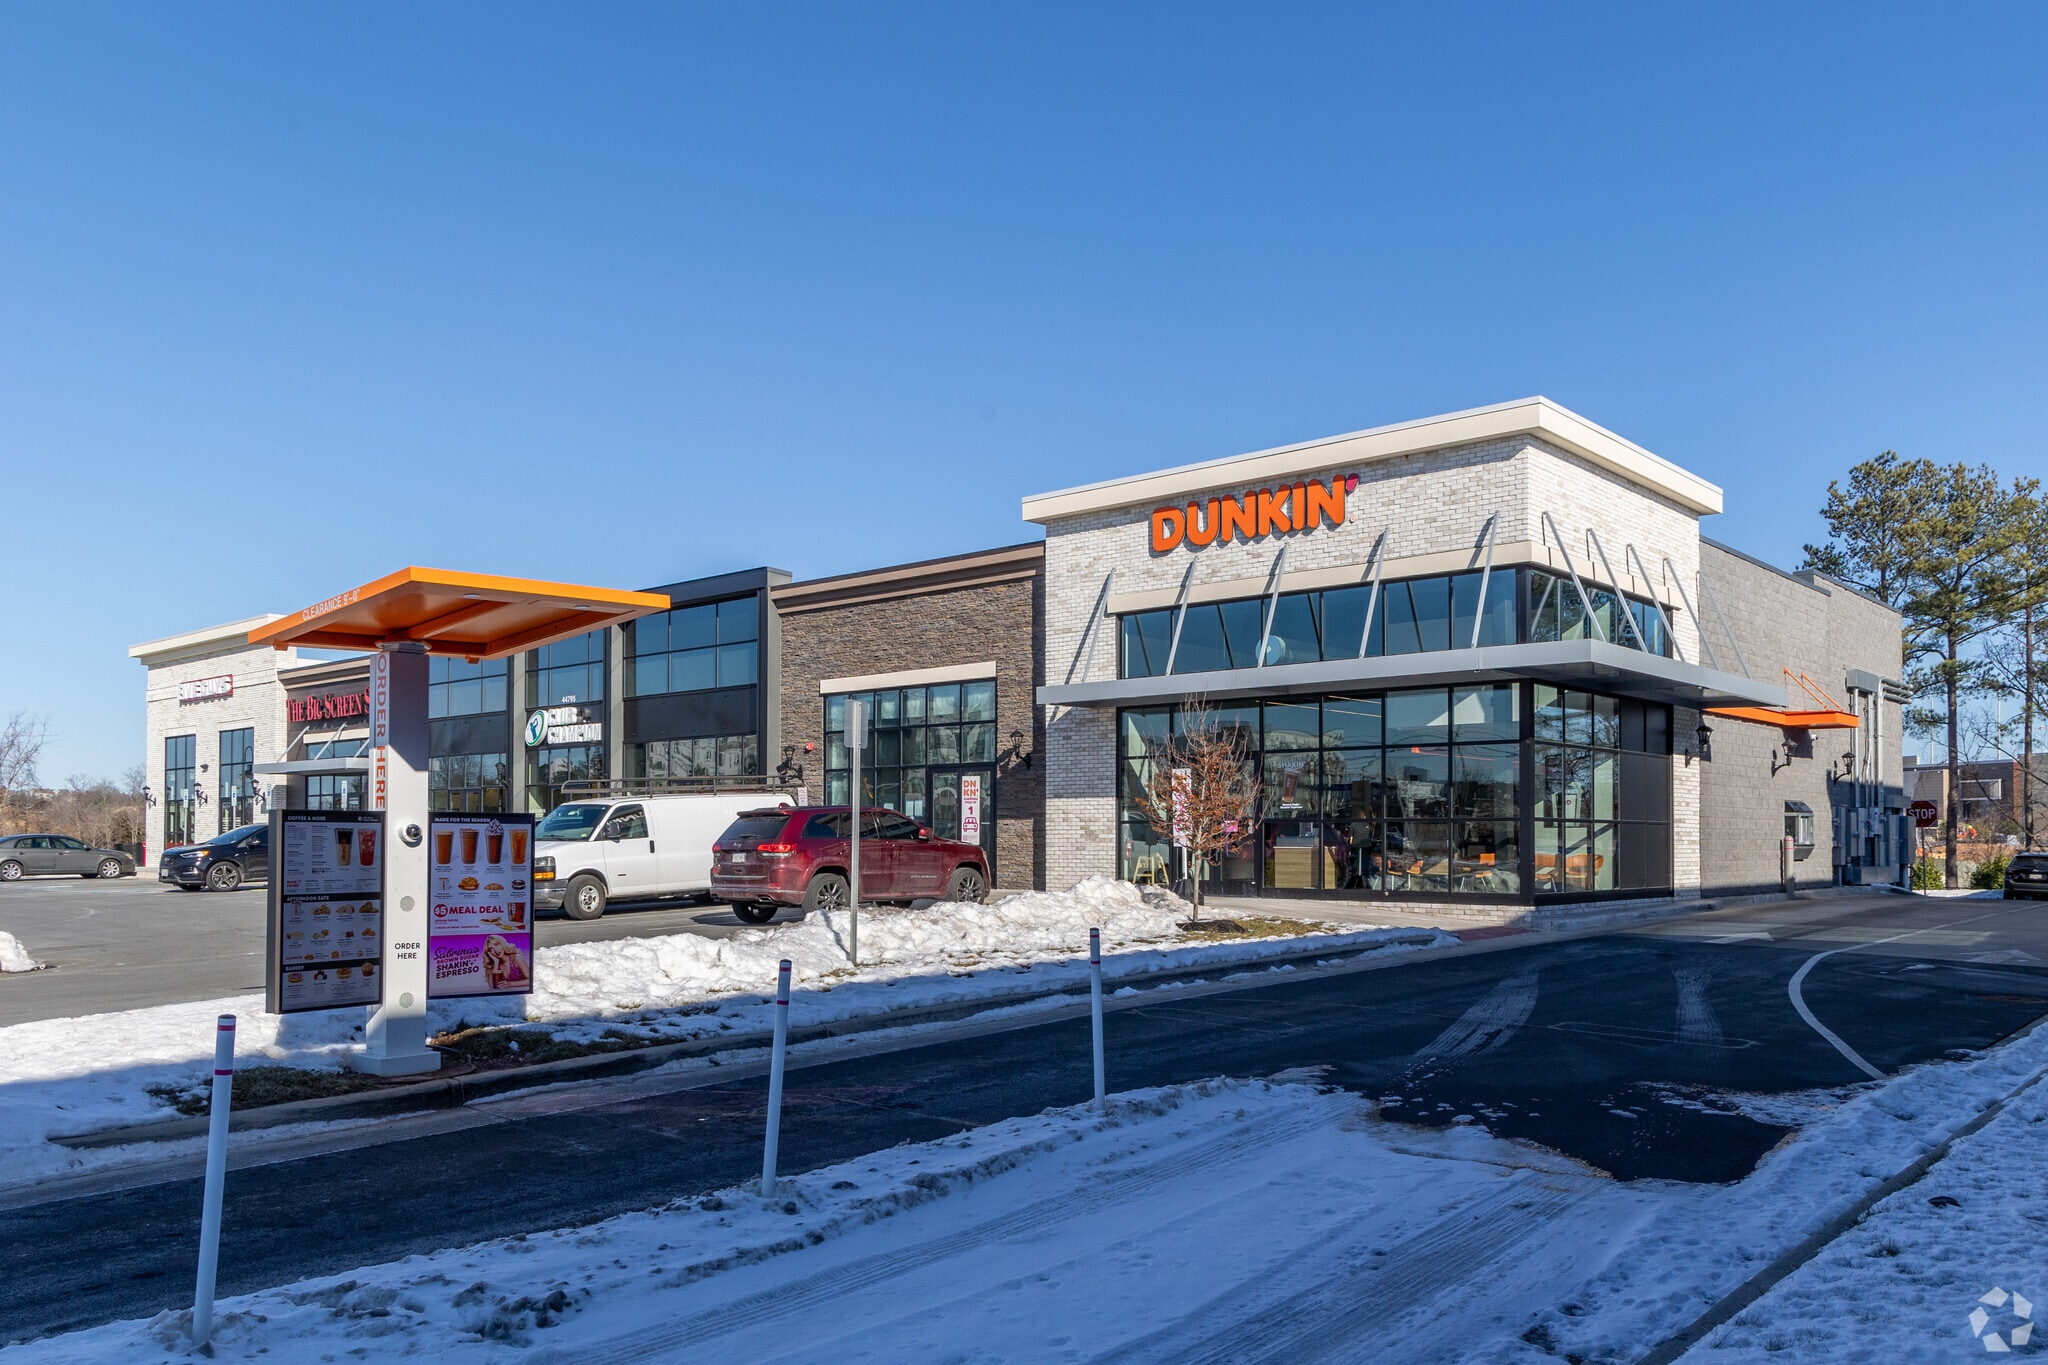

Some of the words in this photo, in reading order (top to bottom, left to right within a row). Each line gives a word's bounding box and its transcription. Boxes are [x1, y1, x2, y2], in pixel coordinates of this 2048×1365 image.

[1152, 472, 1360, 552] DUNKIN'
[302, 597, 342, 621] CLEARANCE
[376, 653, 387, 738] ORDER
[561, 695, 576, 703] 44795
[286, 698, 305, 723] THE
[307, 695, 323, 721] BIG
[324, 692, 362, 719] SCREEN
[548, 706, 578, 727] CLUB
[547, 722, 602, 744] CHAMPION
[375, 745, 387, 809] HERE
[963, 780, 977, 788] DN
[968, 806, 973, 815] 1
[1908, 808, 1936, 820] STOP
[434, 905, 447, 915] $5
[449, 906, 477, 915] MEAL
[479, 905, 504, 914] DEAL
[394, 942, 421, 950] ORDER
[433, 945, 480, 960] Sabrina's
[397, 952, 417, 960] HERE
[436, 960, 471, 972] SHAKIN'
[436, 966, 480, 979] ESPRESSO
